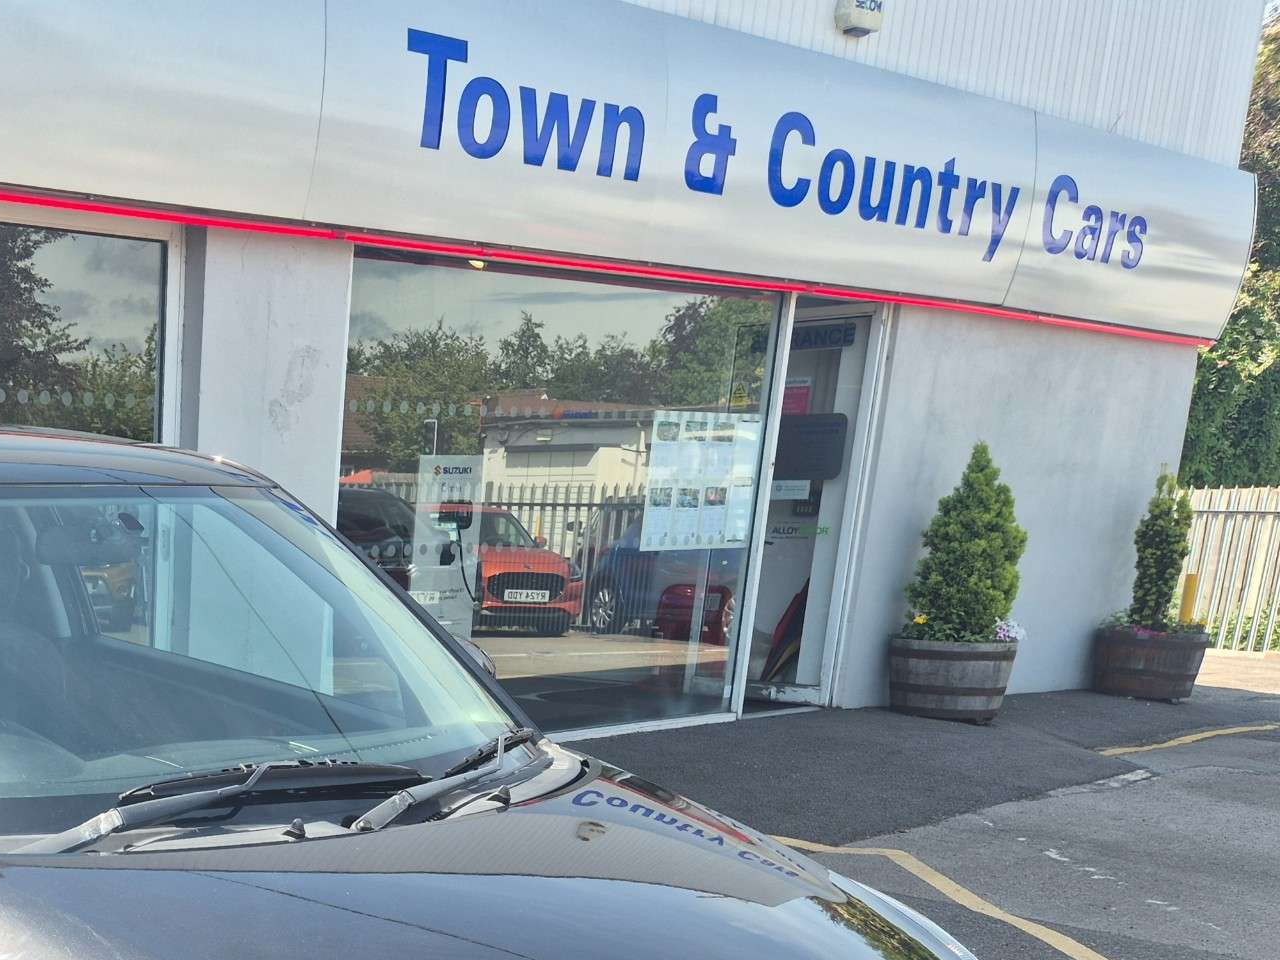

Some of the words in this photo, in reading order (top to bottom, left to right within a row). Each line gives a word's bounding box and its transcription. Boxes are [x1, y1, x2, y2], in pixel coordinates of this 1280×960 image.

[407, 27, 645, 182] Town
[684, 92, 736, 196] &
[767, 110, 1020, 263] Country
[1041, 174, 1148, 270] Cars
[442, 466, 472, 475] SUZUKI
